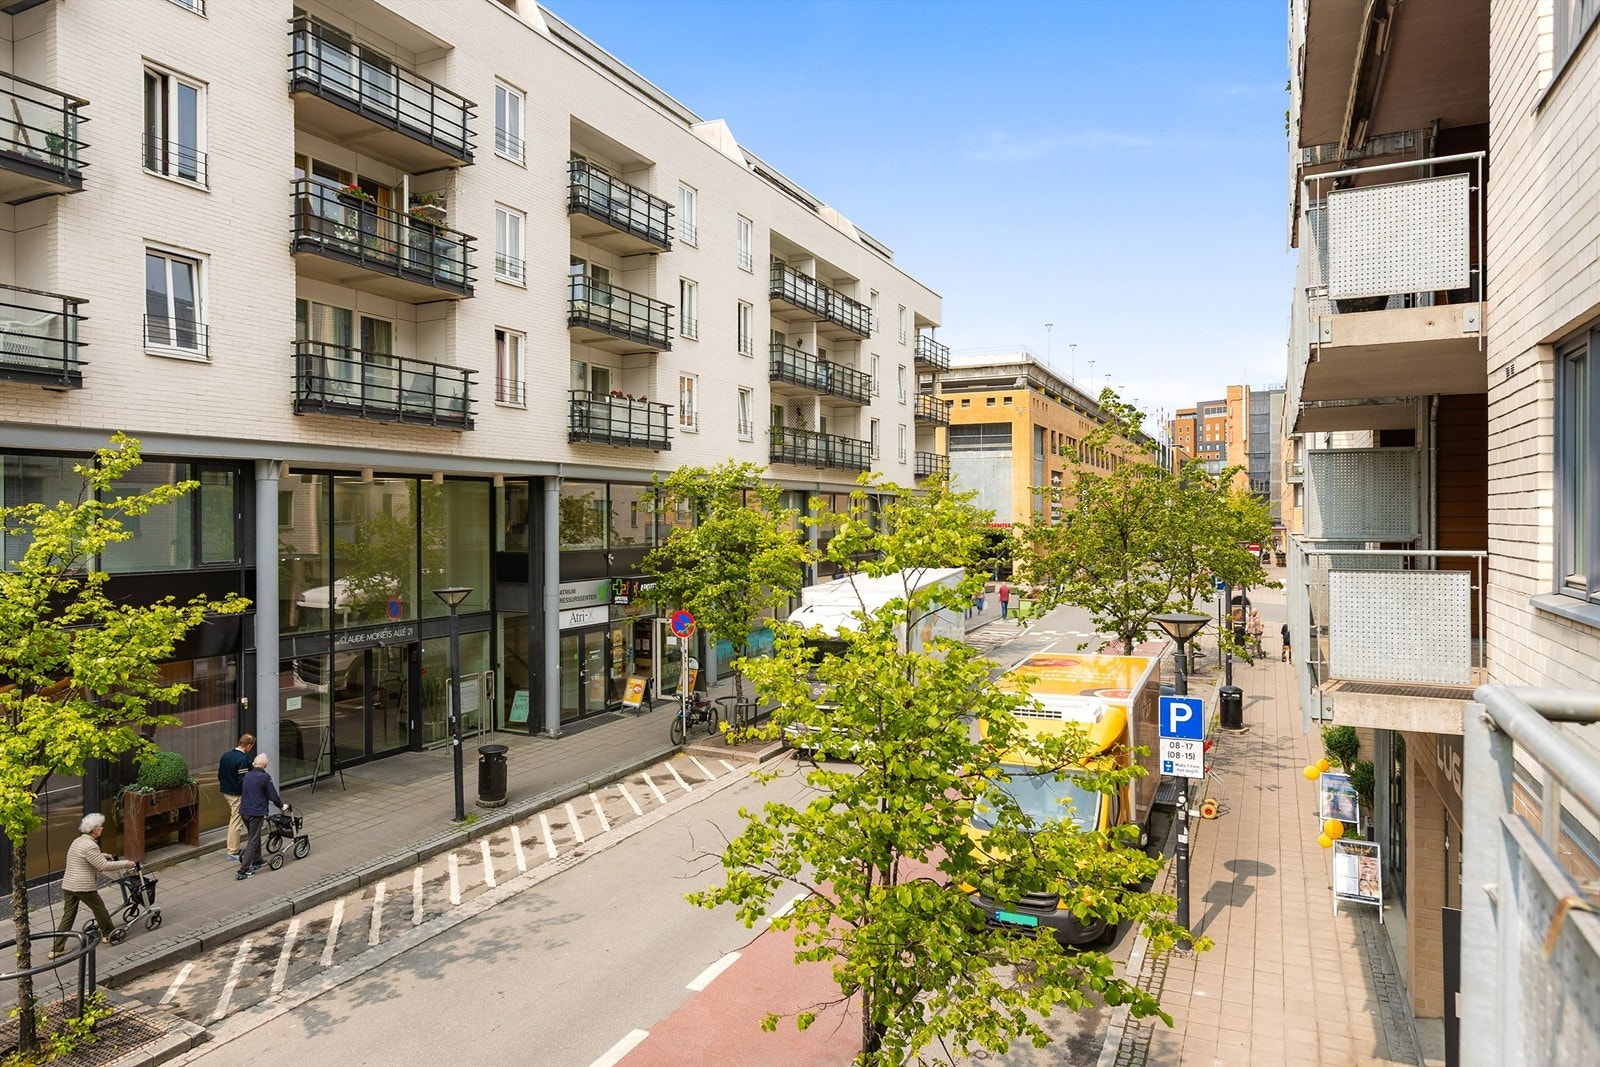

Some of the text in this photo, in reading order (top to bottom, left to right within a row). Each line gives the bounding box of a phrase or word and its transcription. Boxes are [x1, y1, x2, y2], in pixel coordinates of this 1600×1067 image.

[340, 634, 365, 645] CLAUDE
[1170, 702, 1193, 733] P
[1437, 734, 1463, 800] LUG
